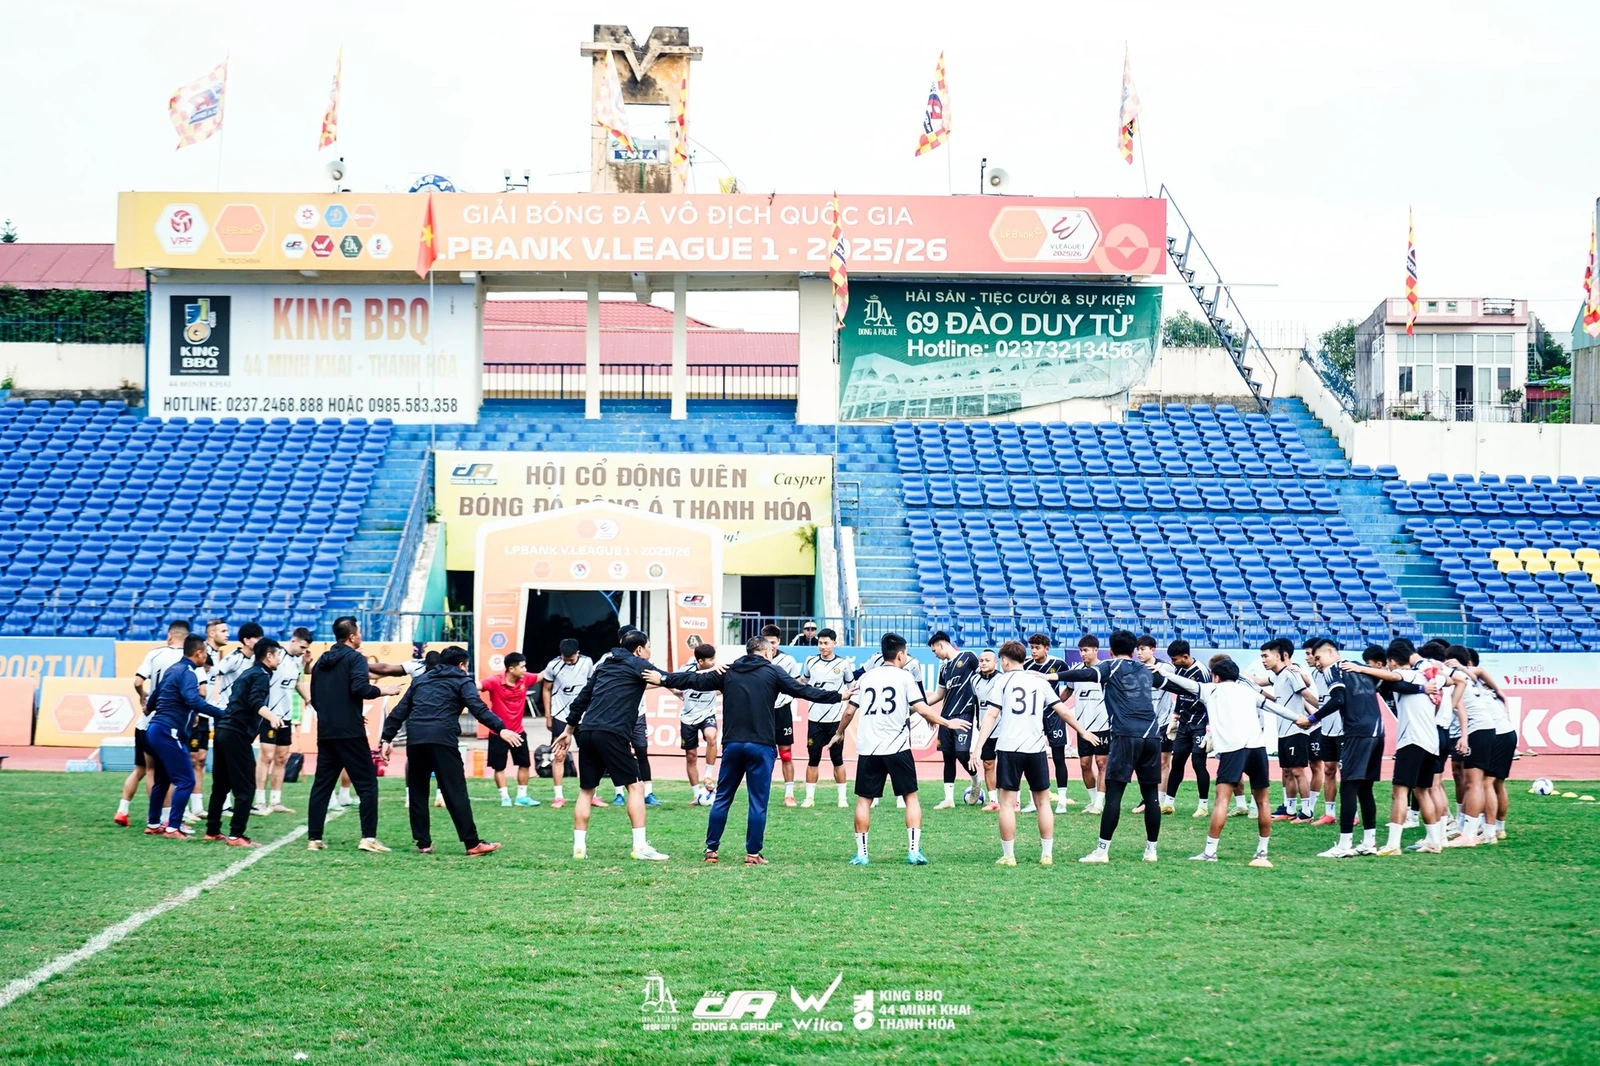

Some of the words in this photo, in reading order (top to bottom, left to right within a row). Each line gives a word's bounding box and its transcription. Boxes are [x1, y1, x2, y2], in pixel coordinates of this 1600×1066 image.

[463, 199, 516, 225] GIẢI
[527, 201, 603, 225] BÓNG
[611, 201, 651, 225] ĐÁ
[660, 201, 698, 225] VÔ
[706, 206, 772, 229] ĐỊCH
[867, 206, 914, 226] GIA
[170, 237, 193, 245] VPF
[437, 237, 573, 260] PBANK
[581, 237, 753, 260] V.LEAGUE
[761, 237, 779, 260] 1
[905, 289, 930, 303] HẢI
[935, 288, 966, 303] SẢN
[979, 291, 1013, 306] TIỆC
[1017, 291, 1057, 305] CƯỚI
[1061, 295, 1071, 305] &
[1076, 295, 1097, 307] SỰ
[1102, 293, 1136, 307] KIỆN
[273, 297, 352, 341] KING
[364, 297, 430, 345] BBQ
[905, 311, 939, 335] 69
[945, 305, 1014, 335] ĐÀO
[1020, 312, 1085, 336] DUY
[1090, 308, 1134, 337] TỪ
[180, 346, 220, 357] KING
[907, 339, 989, 358] Hotline:
[995, 341, 1134, 359] 02373213456
[182, 357, 218, 368] BBQ
[243, 354, 263, 378] 44
[267, 354, 311, 378] MINH
[316, 354, 352, 378] KHAI
[369, 354, 432, 378] THANH
[163, 397, 223, 413] HOTLINE:
[226, 398, 323, 413] 0237.2468.888
[328, 395, 364, 415] HOẶC
[368, 398, 458, 413] 0985.583.358
[526, 461, 566, 490] HỘI
[575, 458, 608, 487] CỔ
[617, 463, 681, 492] ĐỘNG
[690, 464, 747, 488] VIÊN
[774, 472, 826, 489] Casper
[459, 492, 524, 517] BÓNG
[672, 499, 755, 520] THANH
[764, 497, 812, 521] HÓA
[504, 545, 559, 557] LPBANK
[560, 546, 622, 557] V.LEAGUE
[623, 546, 631, 557] 1
[641, 546, 692, 557] 2025/26
[1503, 675, 1559, 685] Visaline
[864, 685, 897, 715] 23
[1011, 686, 1037, 715] 31
[957, 733, 968, 744] 67
[1052, 730, 1063, 739] 50
[1288, 746, 1296, 756] 7
[1310, 742, 1321, 752] 32
